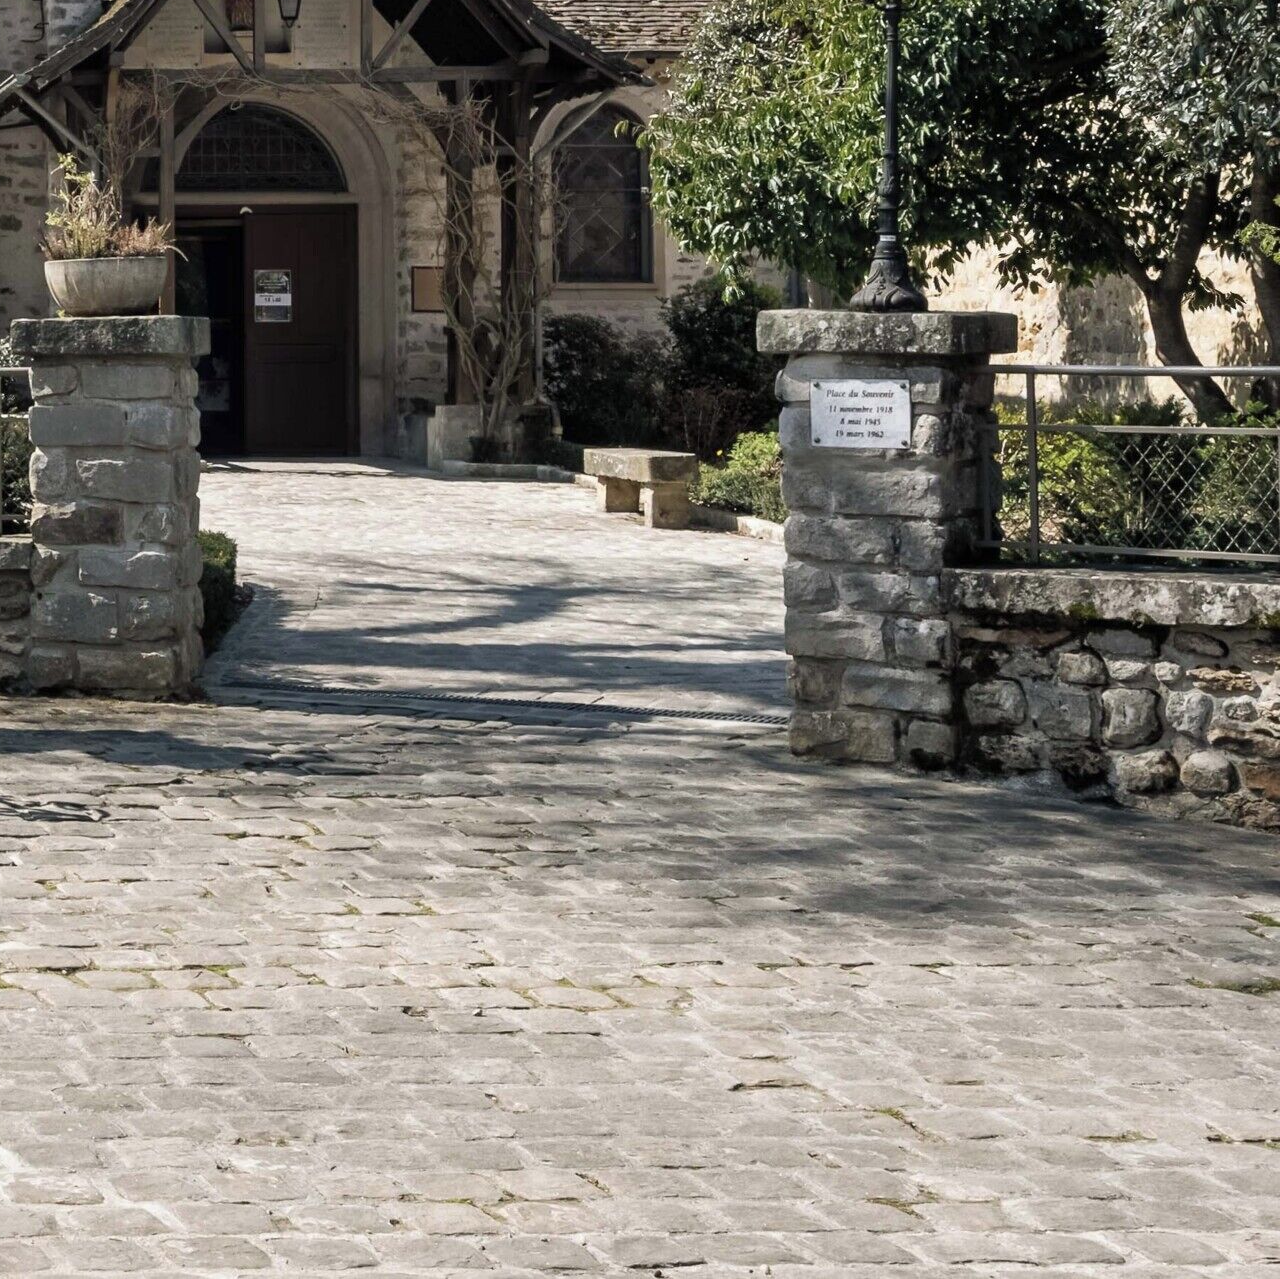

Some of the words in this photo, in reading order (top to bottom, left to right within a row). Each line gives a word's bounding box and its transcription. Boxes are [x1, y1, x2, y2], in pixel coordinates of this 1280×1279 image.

[826, 390, 846, 398] Place
[848, 390, 858, 398] du
[862, 390, 894, 398] Souvenir
